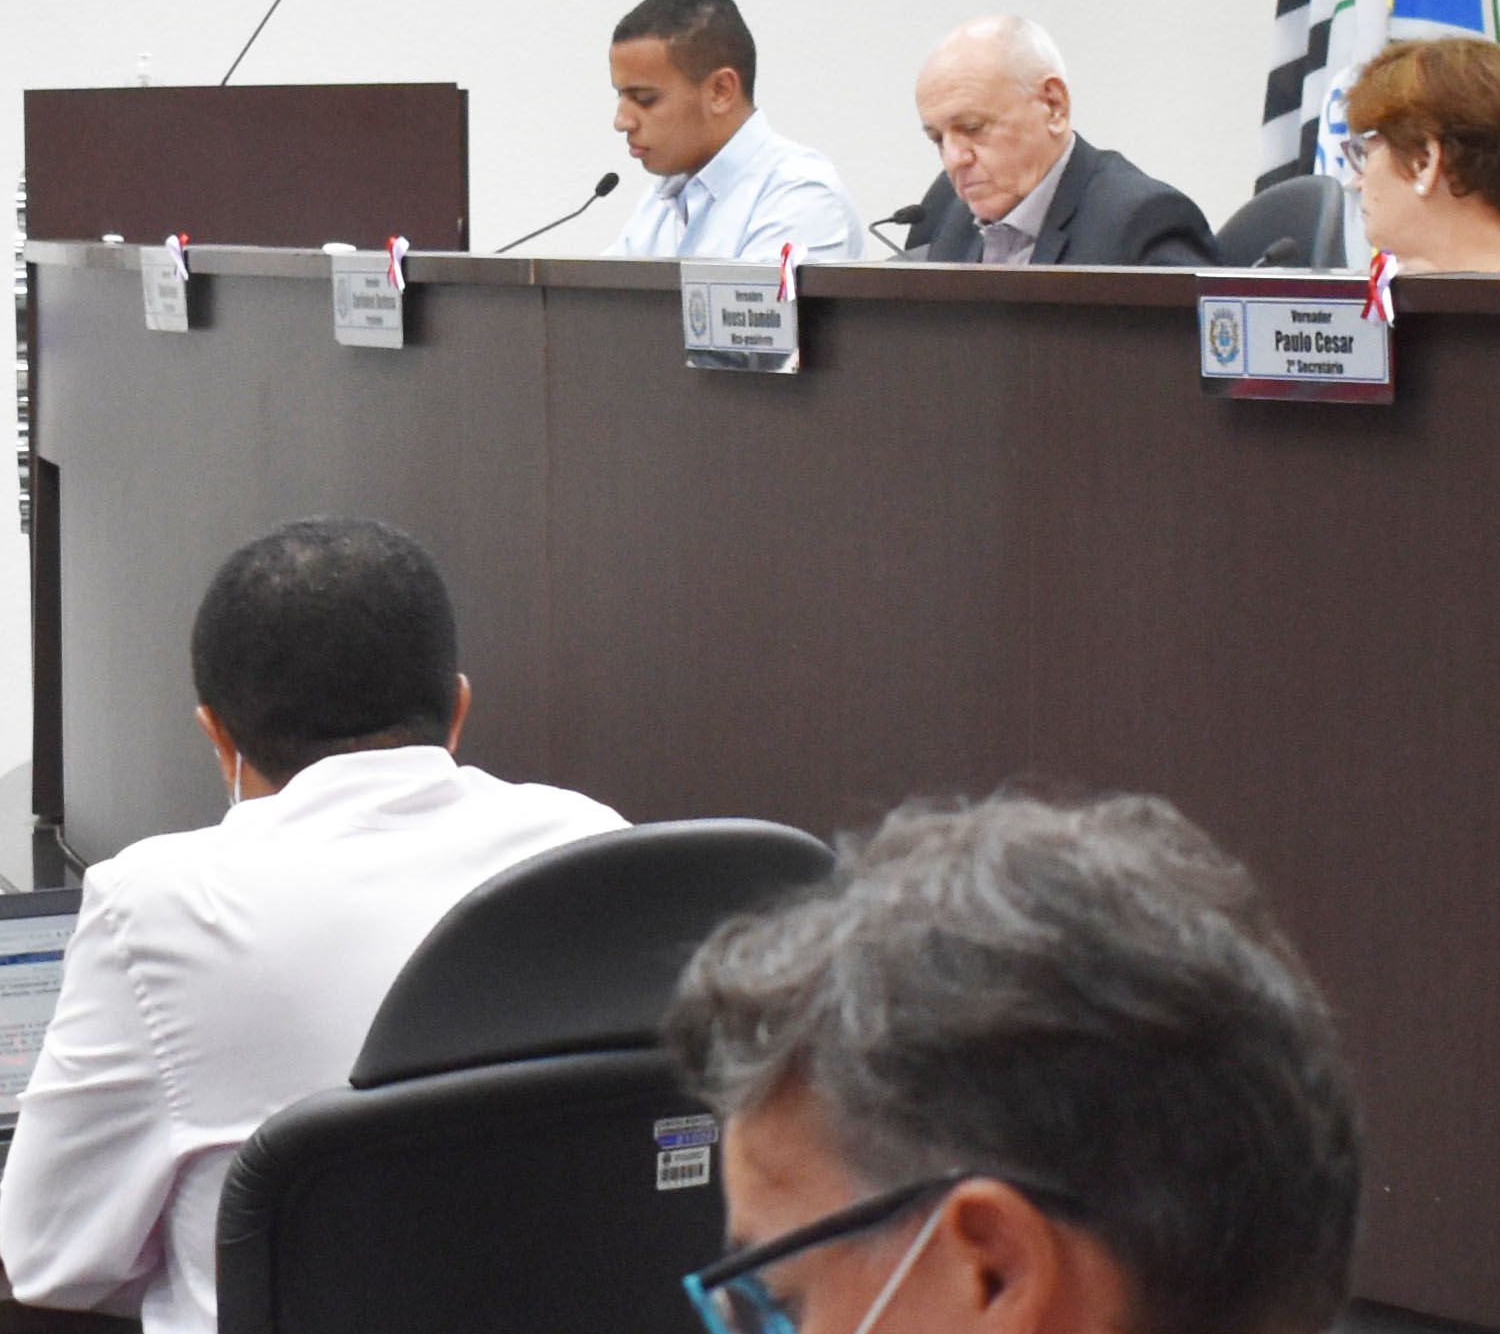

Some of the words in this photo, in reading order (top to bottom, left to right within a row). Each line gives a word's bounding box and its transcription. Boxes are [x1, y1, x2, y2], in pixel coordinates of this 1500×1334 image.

[1290, 309, 1332, 324] Vereador
[1274, 330, 1312, 352] Paulo
[1314, 331, 1354, 354] Cesar
[1297, 360, 1344, 375] Secretário
